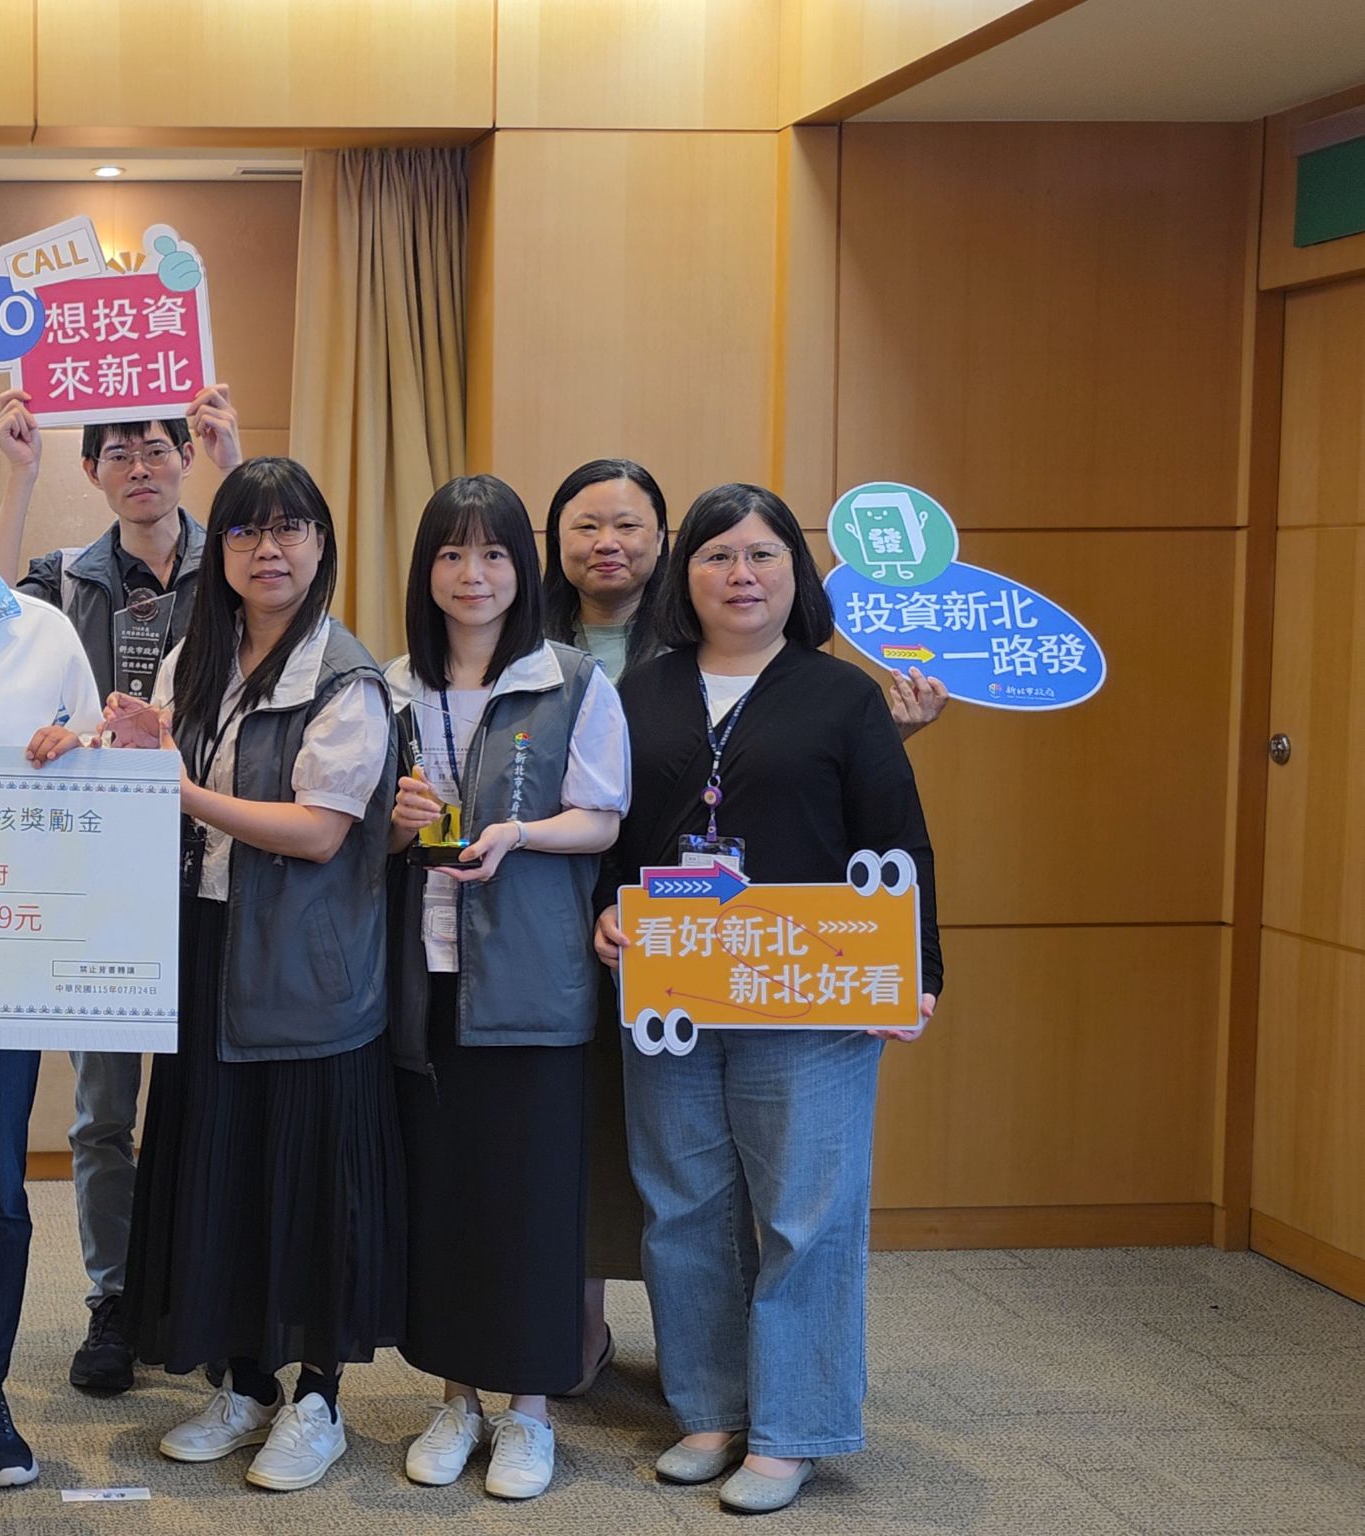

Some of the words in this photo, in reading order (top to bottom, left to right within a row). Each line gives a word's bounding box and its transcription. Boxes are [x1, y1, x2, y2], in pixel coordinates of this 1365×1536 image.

[11, 240, 89, 279] CALL
[44, 295, 188, 345] 想投資
[47, 351, 193, 402] 來新北
[867, 527, 904, 554] 發
[846, 589, 1039, 634] 投資新北
[942, 633, 1087, 678] 一路發
[635, 915, 810, 959] 看好新北
[55, 984, 157, 995] 中華民國115年07月24日
[729, 963, 904, 1006] 新北好看
